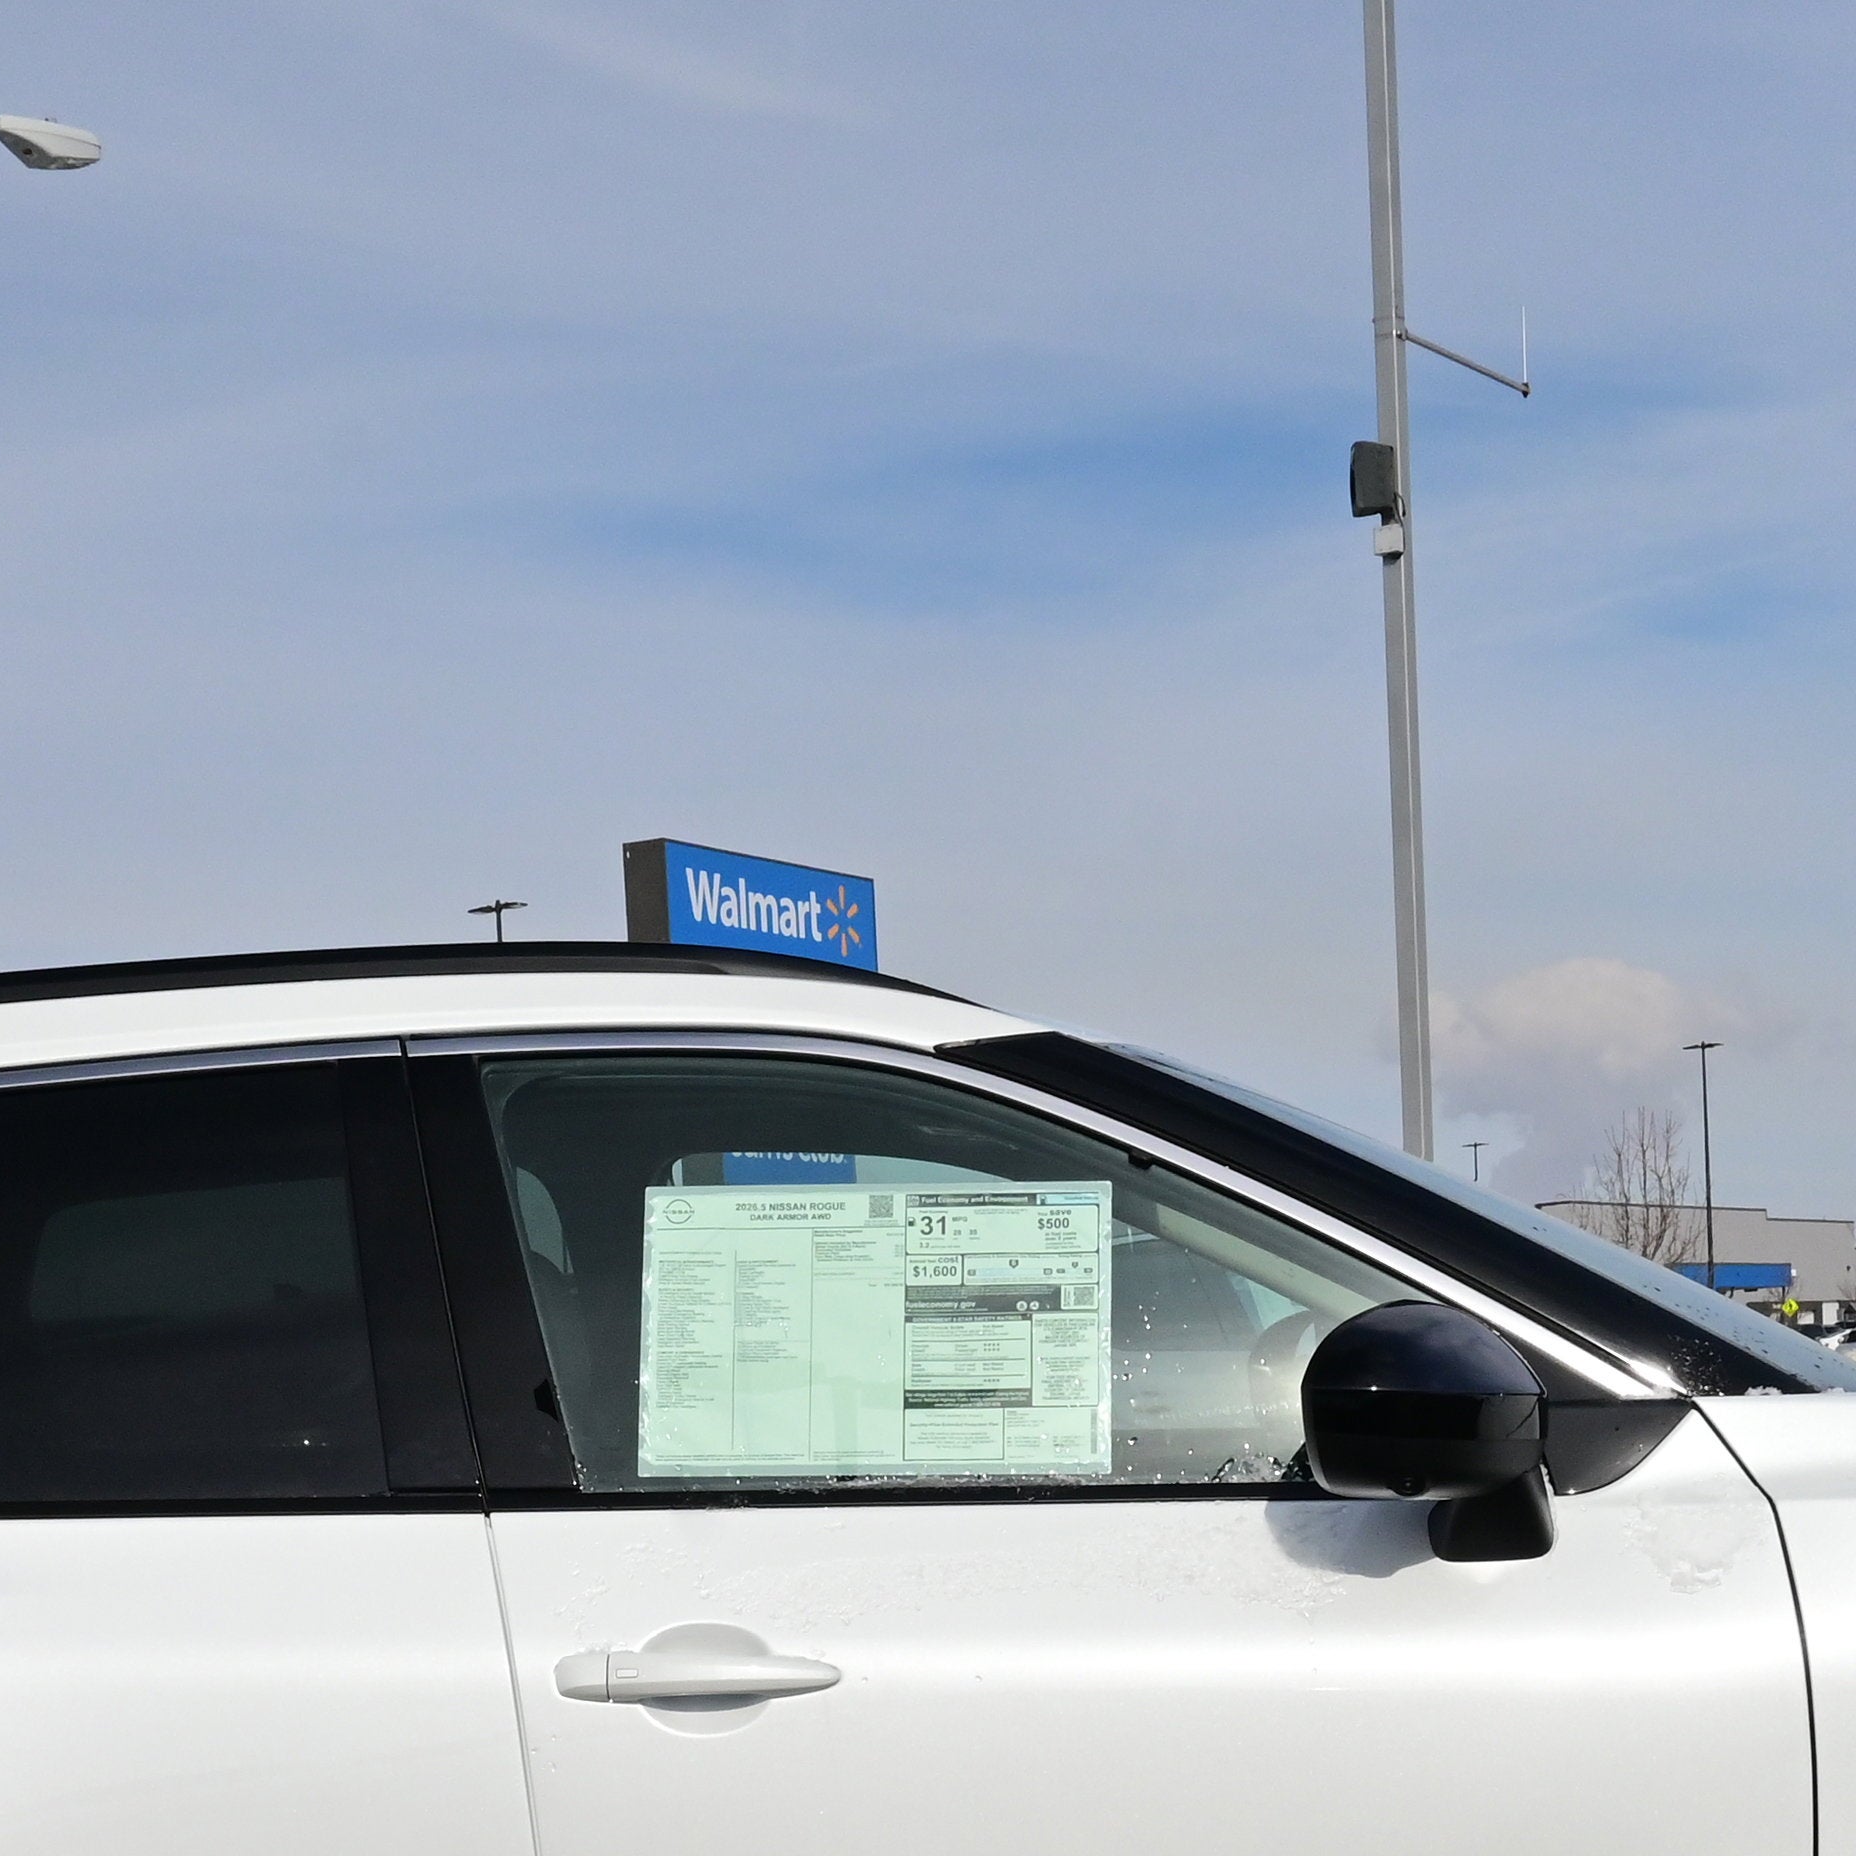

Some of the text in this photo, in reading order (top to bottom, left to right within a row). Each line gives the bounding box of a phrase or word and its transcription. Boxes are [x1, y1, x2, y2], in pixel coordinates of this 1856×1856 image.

[685, 867, 822, 942] Walmart
[769, 1203, 806, 1211] NISSAN
[809, 1202, 846, 1211] ROGUE
[920, 1215, 946, 1235] 31
[1037, 1217, 1070, 1230] $500
[938, 1256, 959, 1264] cost
[913, 1265, 957, 1278] $1,600
